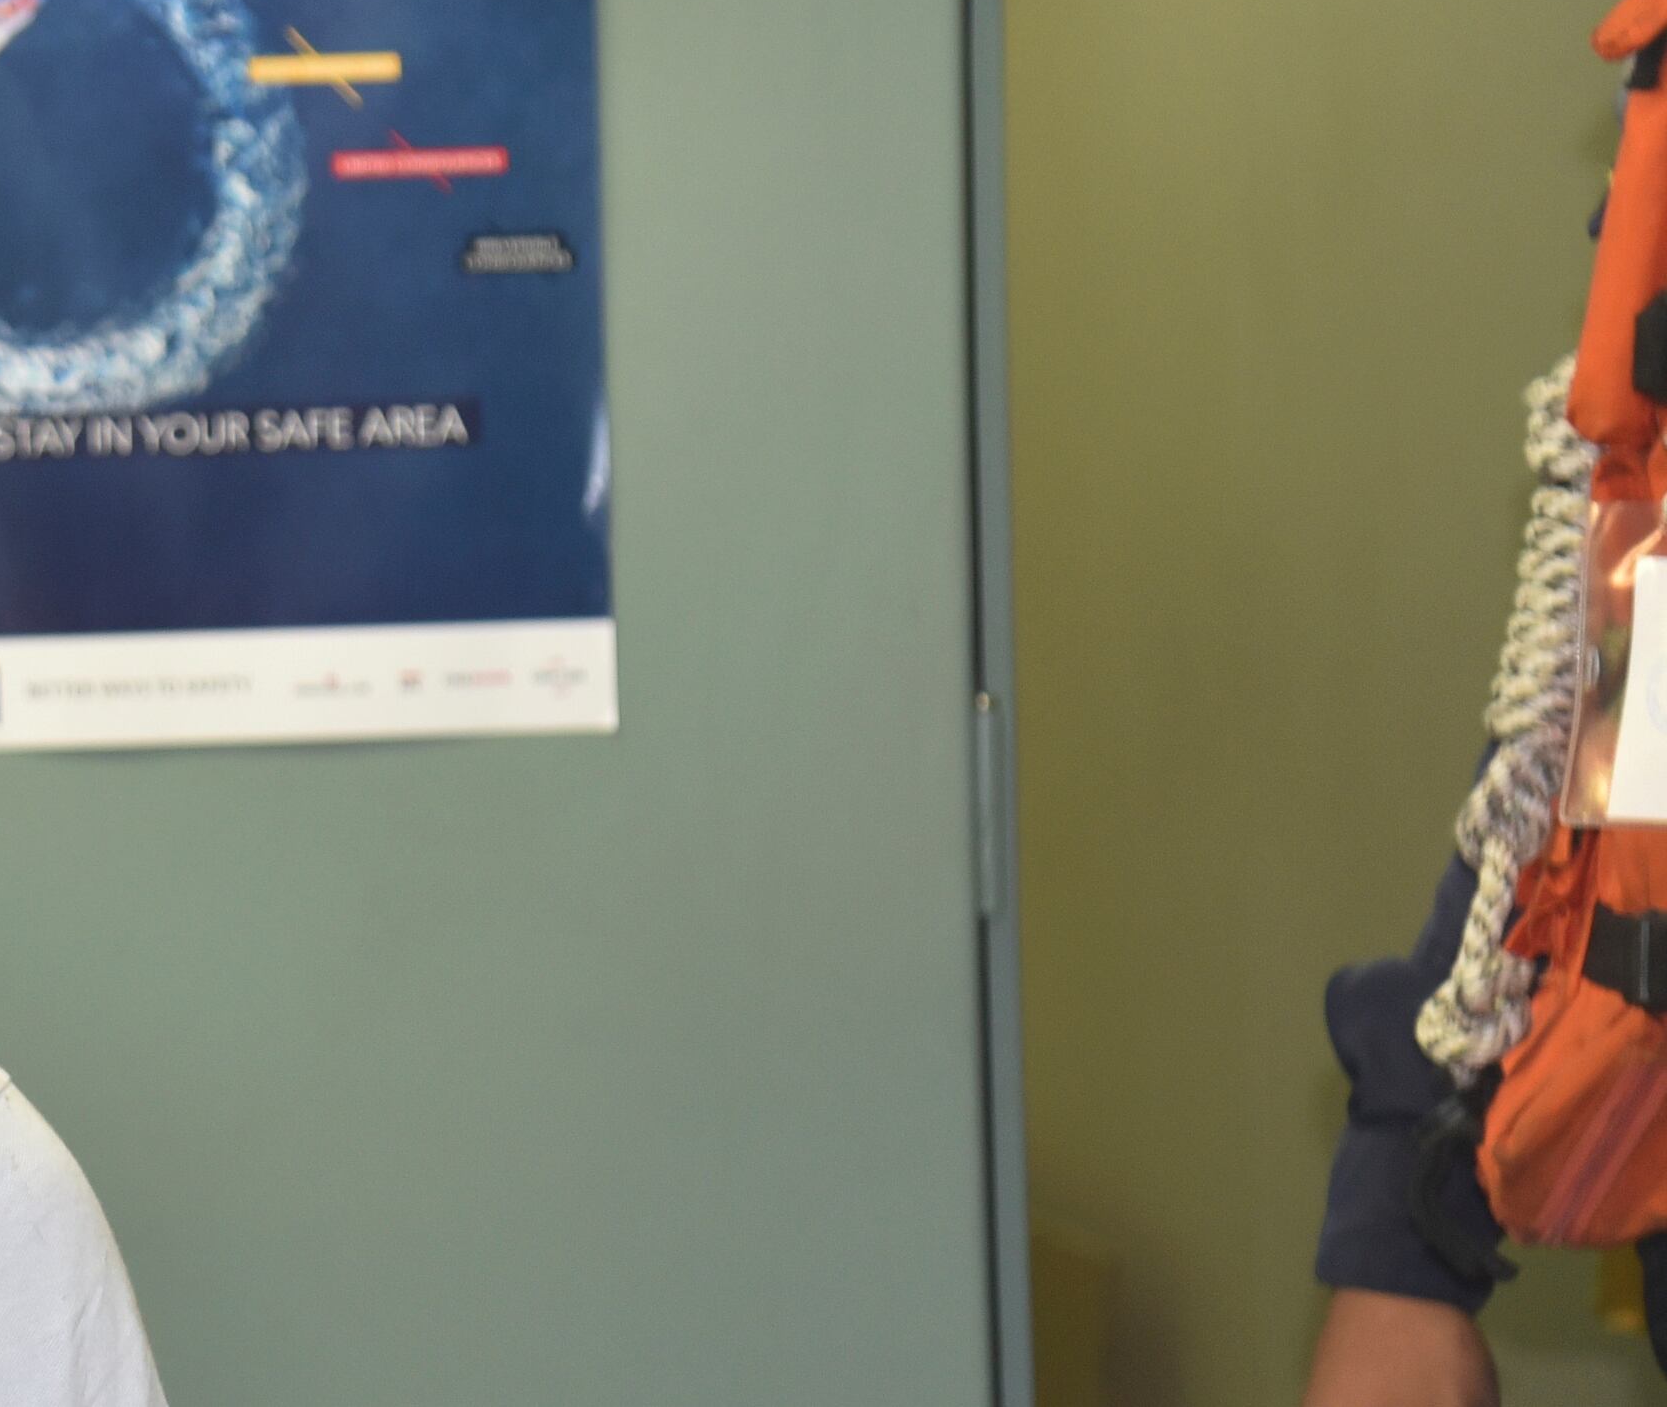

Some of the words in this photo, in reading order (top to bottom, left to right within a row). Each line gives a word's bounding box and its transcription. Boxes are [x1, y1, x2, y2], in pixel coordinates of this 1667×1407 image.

[86, 415, 133, 457] IN
[136, 410, 250, 456] YOUR
[254, 406, 354, 452] SAFE
[359, 403, 469, 449] AREA
